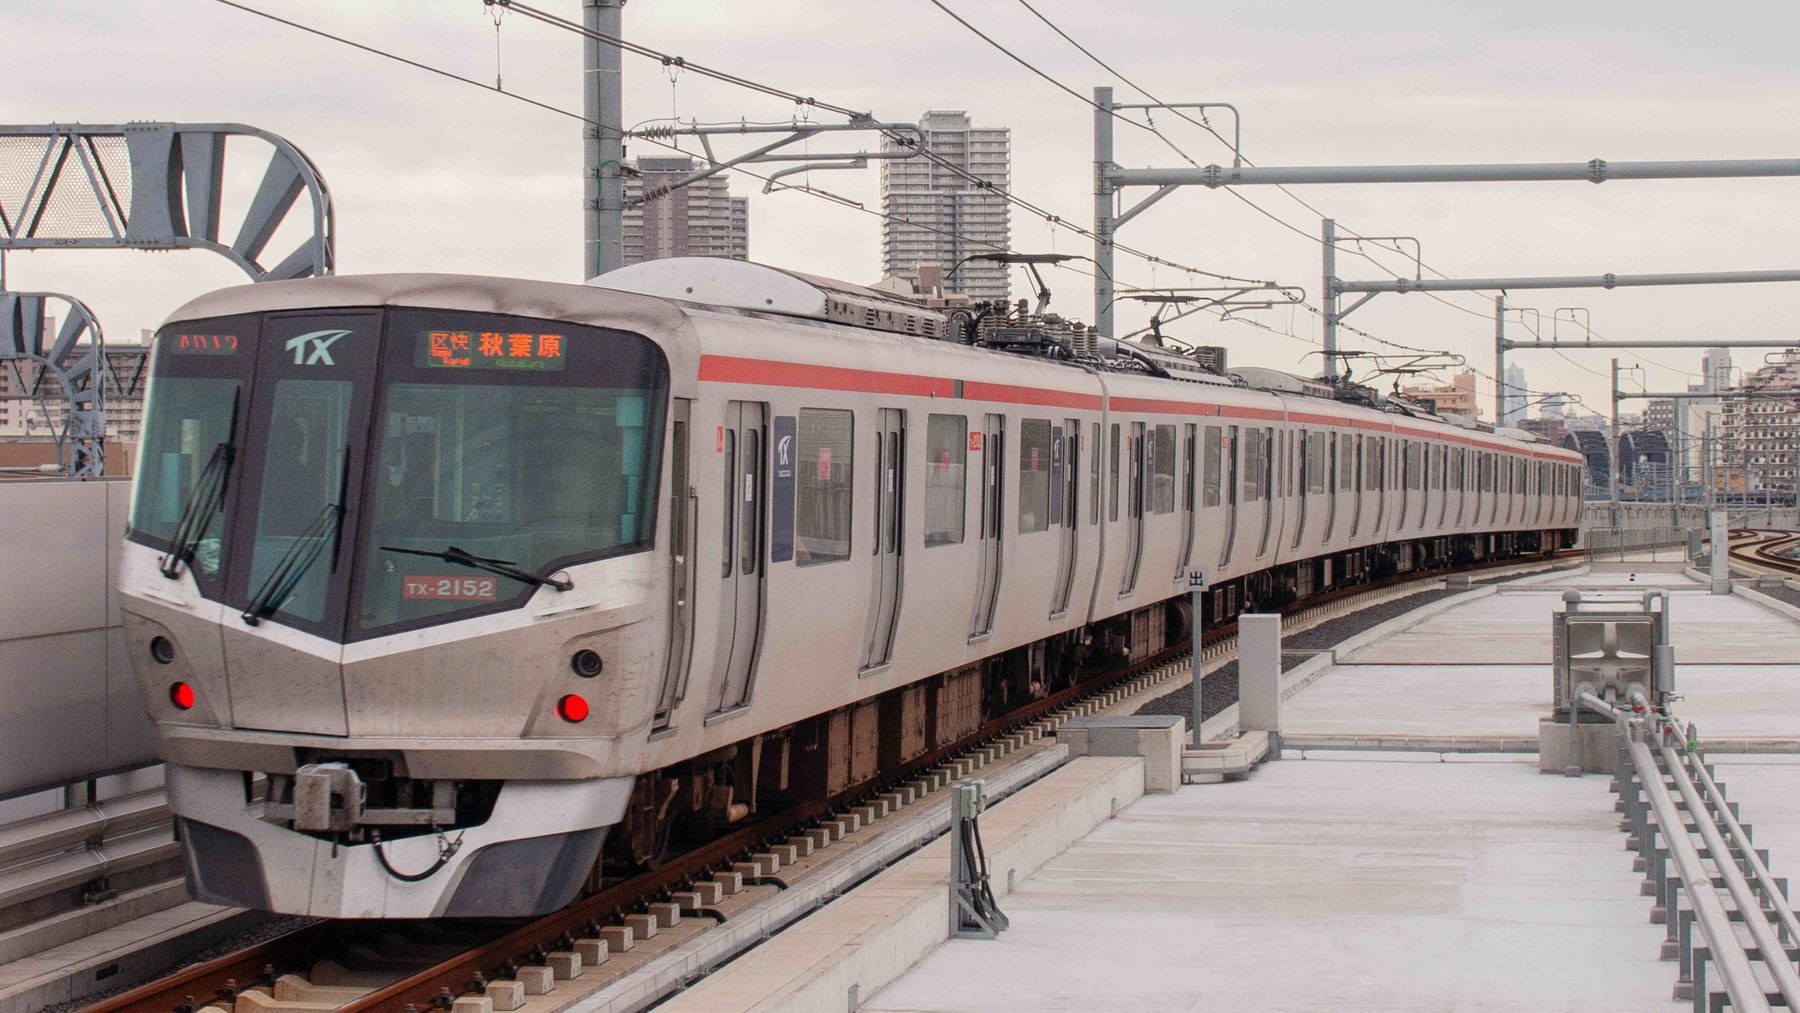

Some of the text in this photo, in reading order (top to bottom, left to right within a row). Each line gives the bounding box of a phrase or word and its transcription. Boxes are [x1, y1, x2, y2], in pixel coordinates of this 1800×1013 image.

[285, 329, 353, 366] TX
[431, 333, 469, 351] 区快
[479, 332, 562, 358] 秋葉原
[1189, 571, 1203, 586] 出
[407, 579, 493, 597] TX-2152
